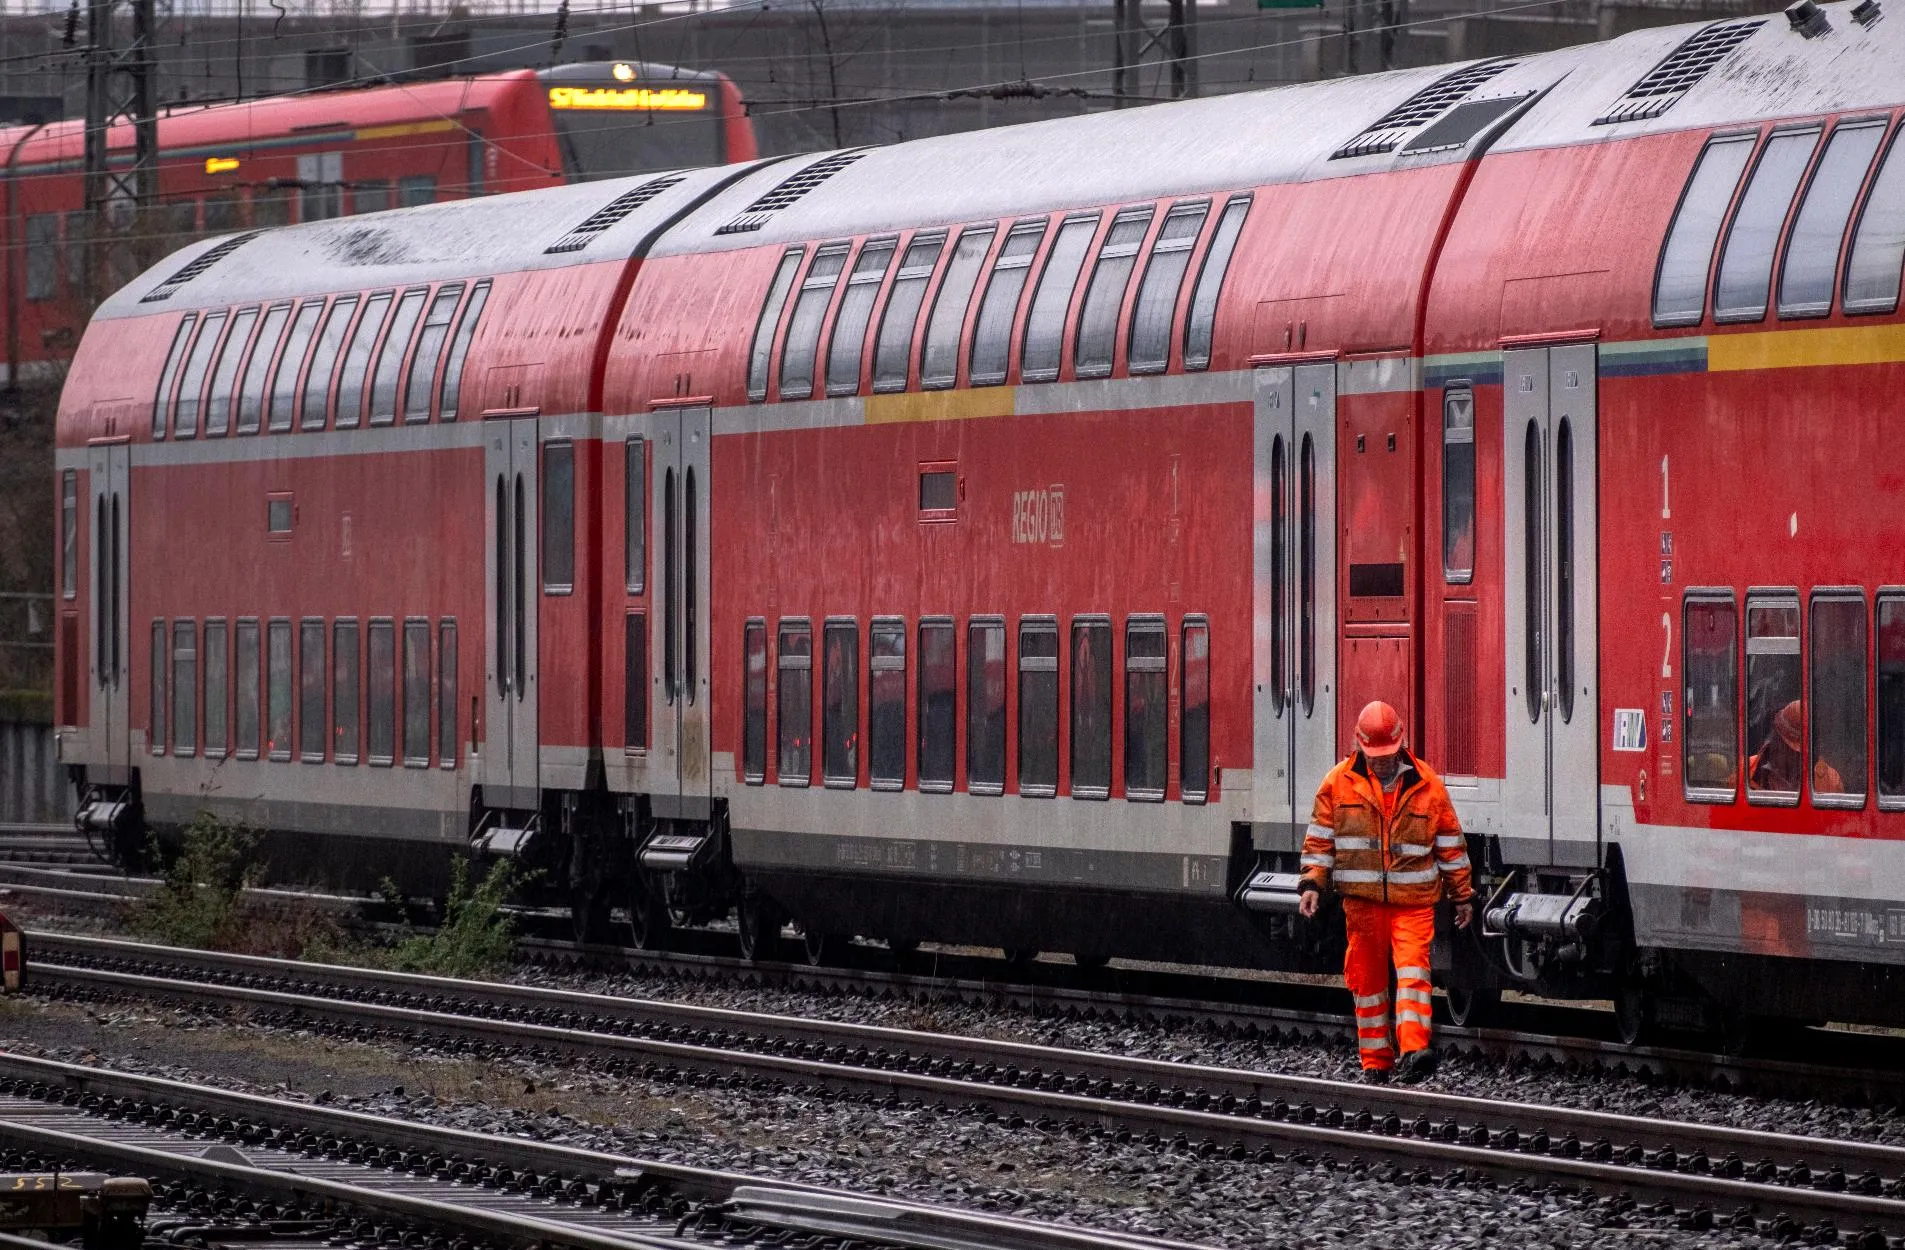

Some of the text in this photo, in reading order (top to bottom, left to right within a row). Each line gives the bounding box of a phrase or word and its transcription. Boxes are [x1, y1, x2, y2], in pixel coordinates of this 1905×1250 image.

[1012, 489, 1047, 543] REGIO
[1661, 454, 1671, 519] 1
[1662, 611, 1672, 678] 2
